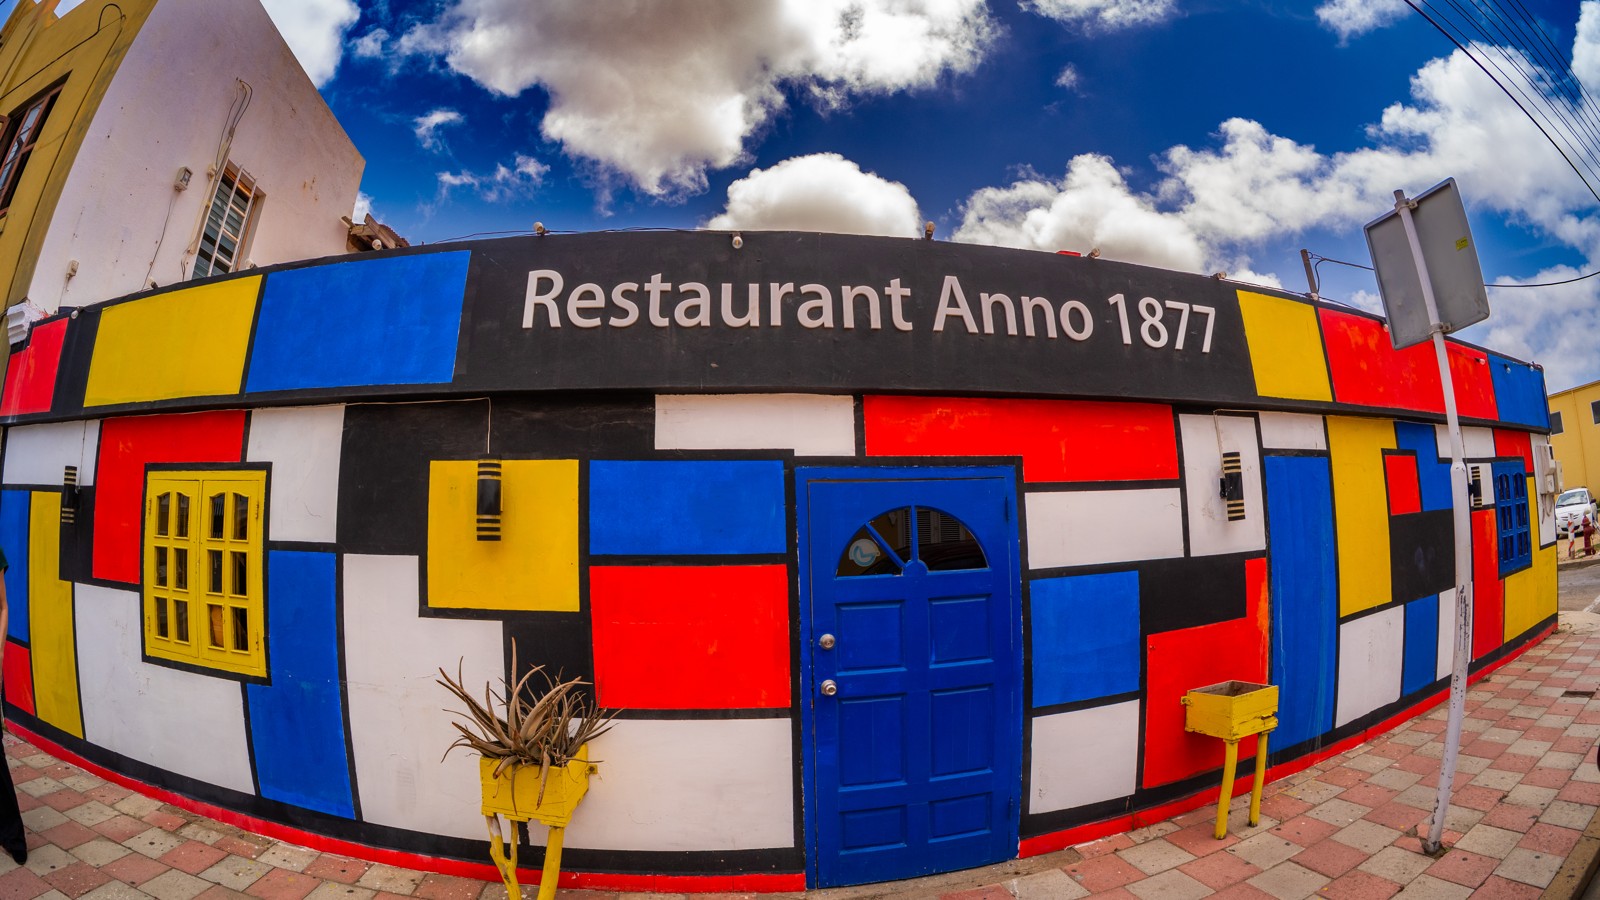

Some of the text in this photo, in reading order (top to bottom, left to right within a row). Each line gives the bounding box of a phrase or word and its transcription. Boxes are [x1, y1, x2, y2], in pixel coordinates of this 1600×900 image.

[521, 268, 1217, 354] Restaurant Anno 1877
